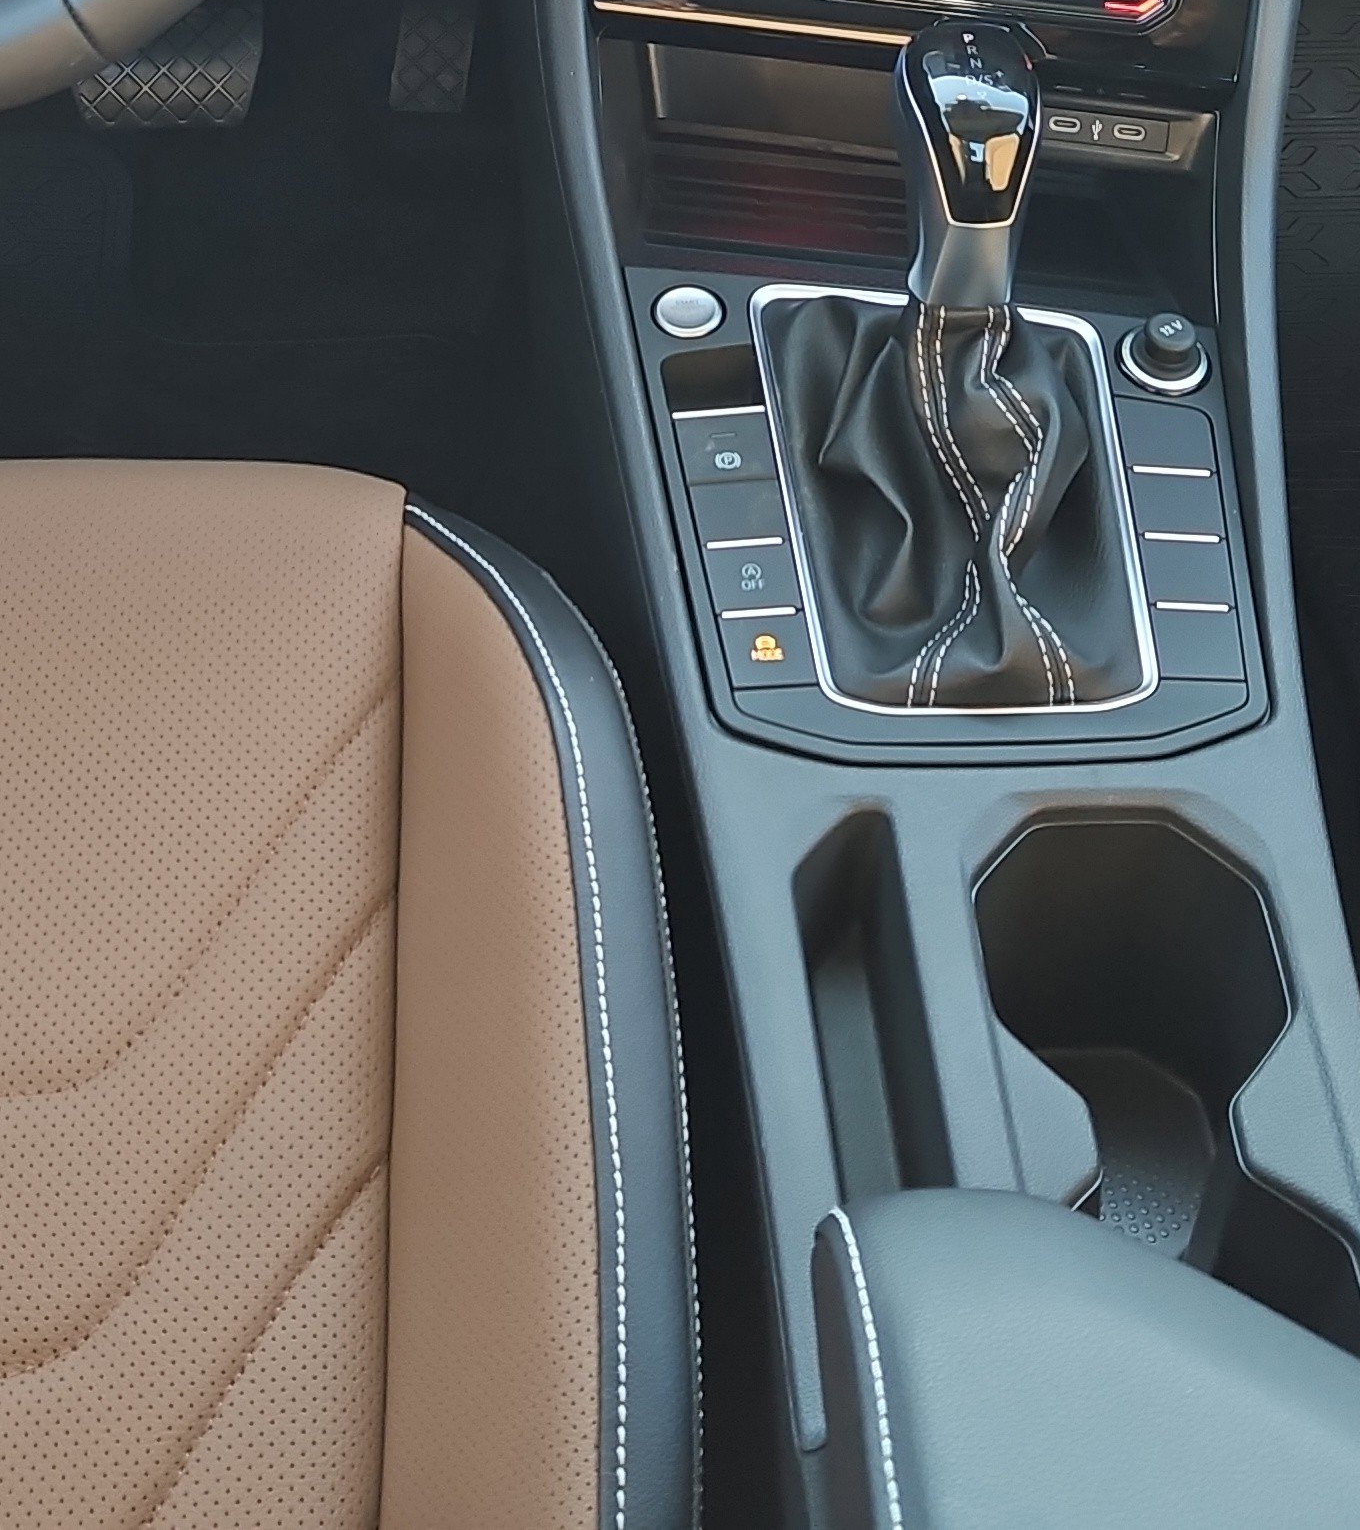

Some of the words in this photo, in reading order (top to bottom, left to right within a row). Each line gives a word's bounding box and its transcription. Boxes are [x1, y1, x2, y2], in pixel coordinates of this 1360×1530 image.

[962, 33, 975, 44] P
[966, 44, 979, 55] R
[969, 57, 983, 69] N
